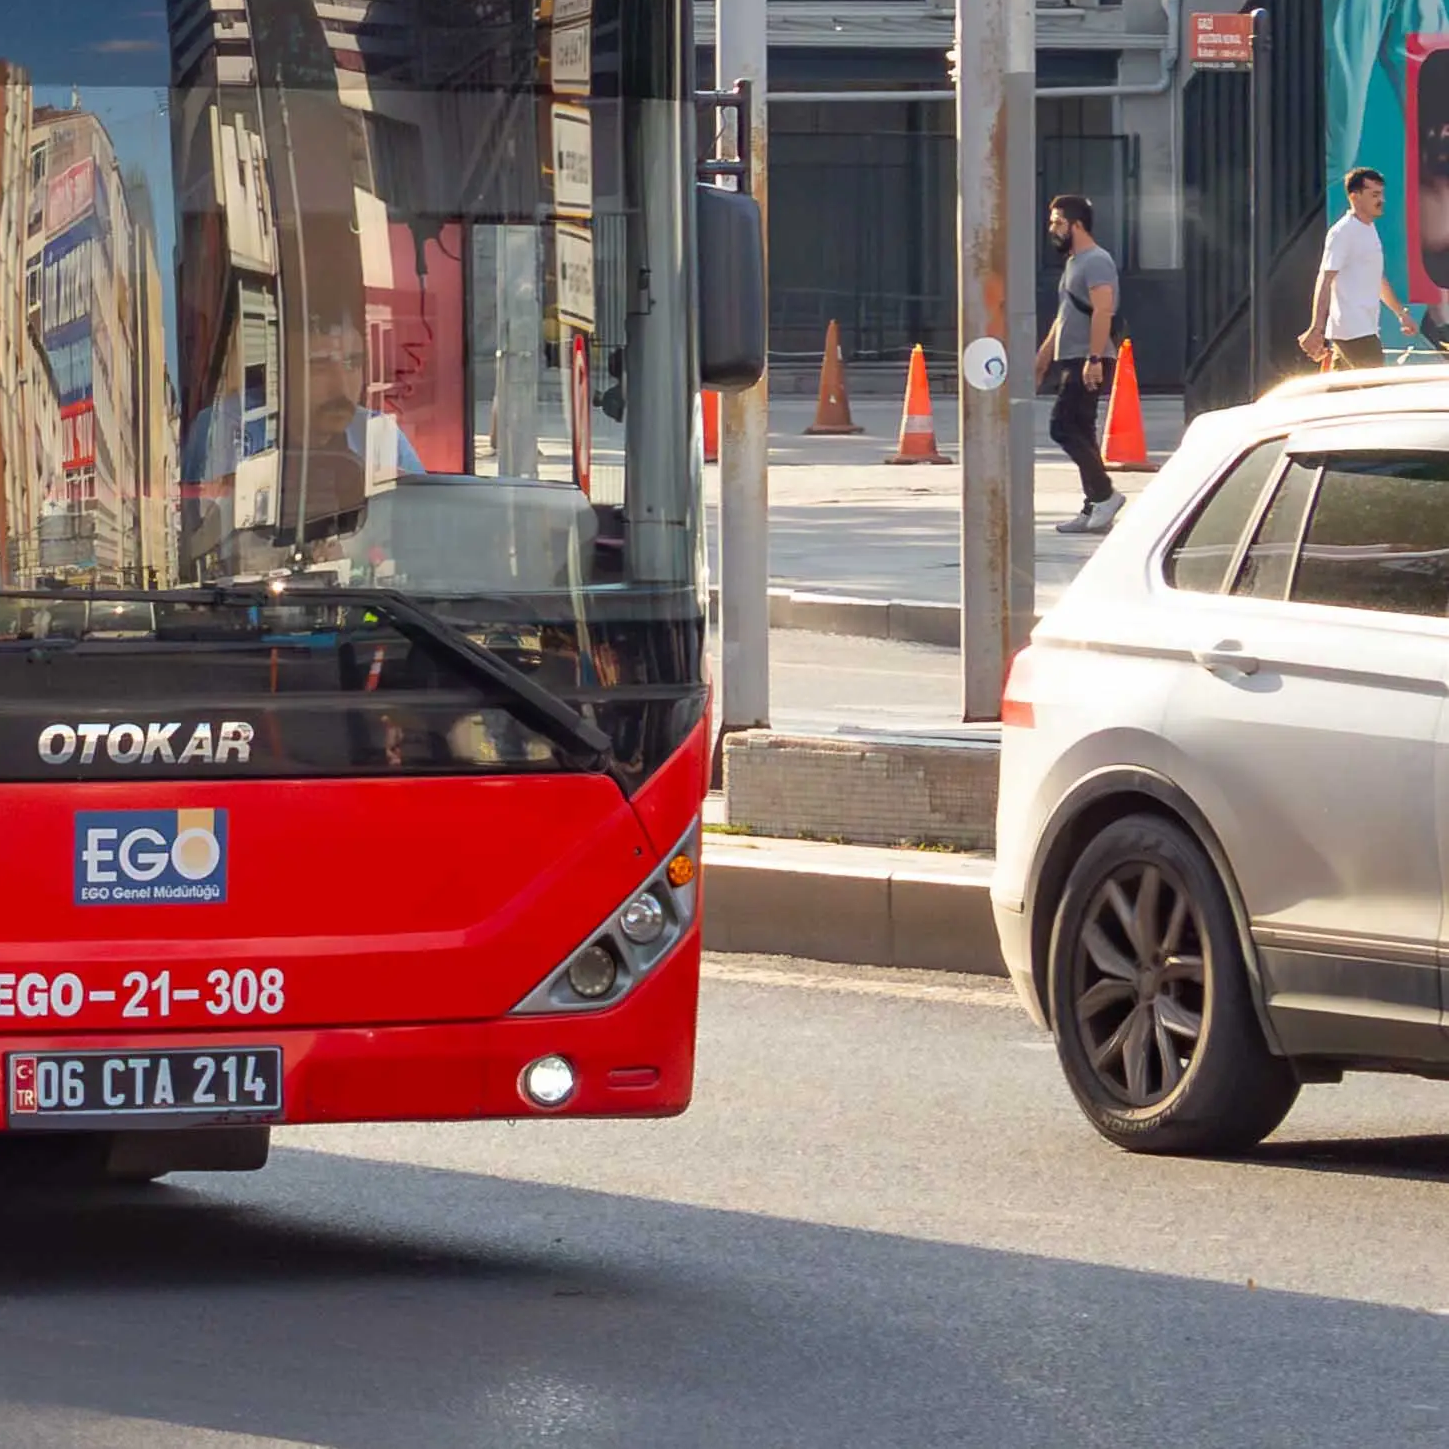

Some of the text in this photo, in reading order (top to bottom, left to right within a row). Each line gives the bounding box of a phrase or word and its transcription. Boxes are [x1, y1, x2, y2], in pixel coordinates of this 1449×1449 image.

[37, 721, 255, 765] OTOKAR
[81, 826, 221, 883] EGO
[80, 883, 220, 902] EGO Genel Müdürlüğü
[16, 1089, 34, 1106] TR
[36, 1054, 267, 1108] 06 CTA 214
